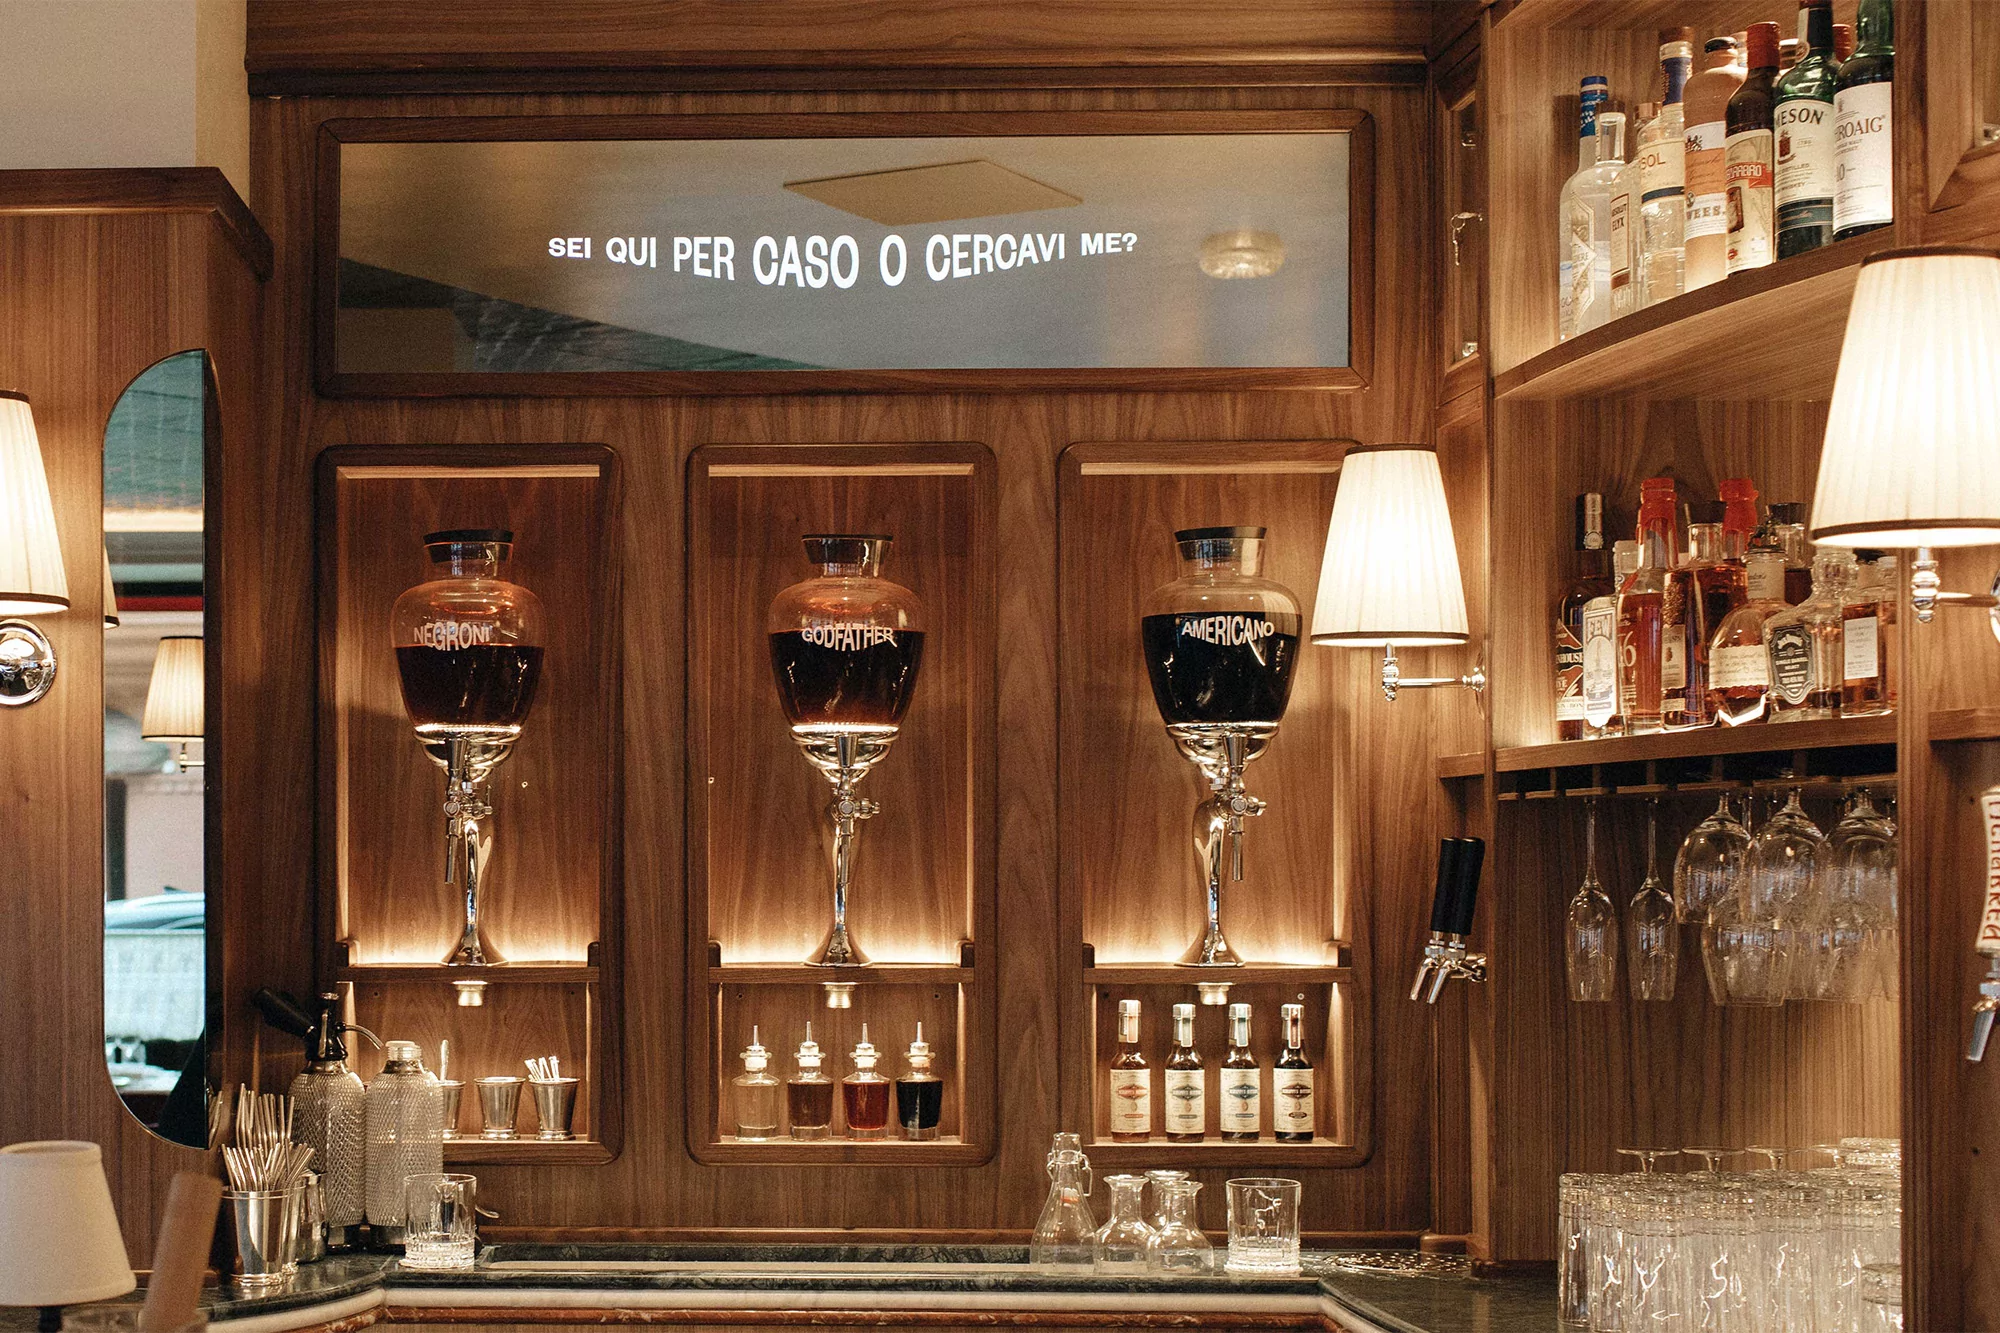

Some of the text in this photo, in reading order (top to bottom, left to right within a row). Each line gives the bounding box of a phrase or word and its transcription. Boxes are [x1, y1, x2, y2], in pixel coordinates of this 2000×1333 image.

[1775, 107, 1824, 127] ESON
[1835, 116, 1884, 141] ROAIG
[548, 232, 1138, 289] SEI QUI PER CASO O CERCAVI ME?
[413, 621, 490, 651] NEGRONI
[801, 623, 895, 652] GODFATHER
[1181, 615, 1275, 646] AMERICANO
